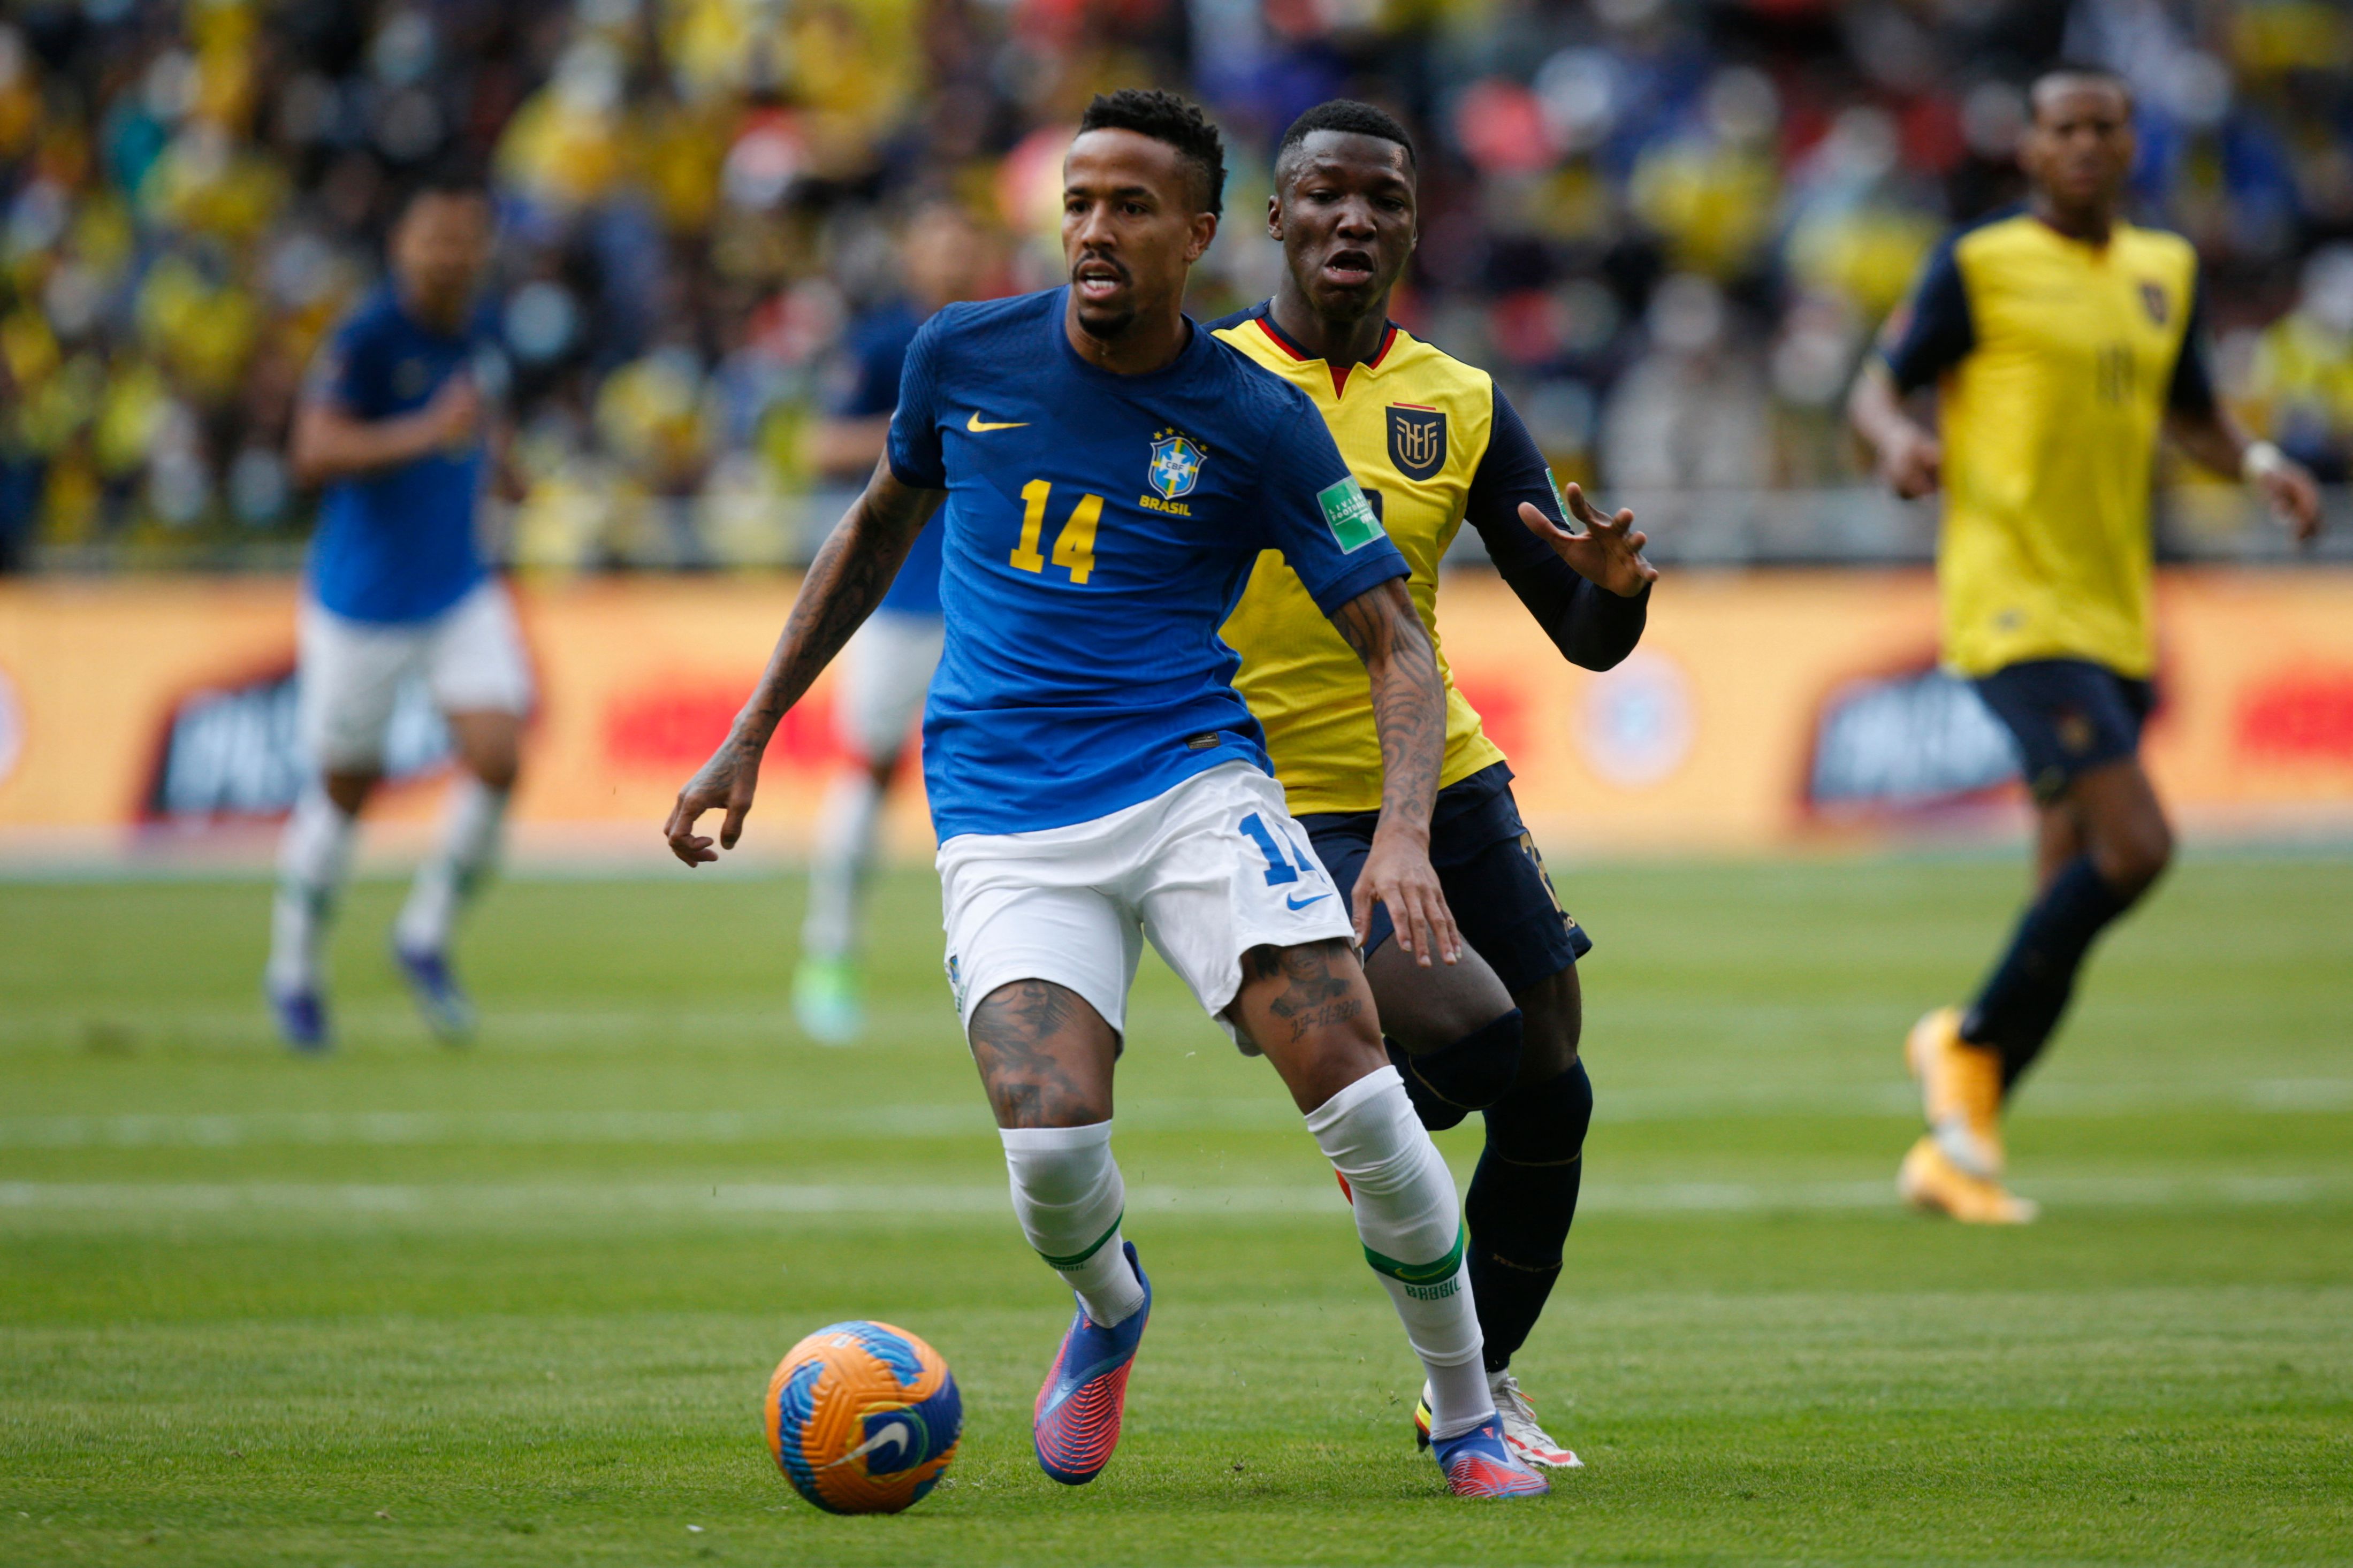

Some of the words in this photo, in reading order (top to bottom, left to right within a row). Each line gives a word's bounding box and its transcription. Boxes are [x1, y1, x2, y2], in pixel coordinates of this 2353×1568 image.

[1166, 461, 1184, 471] CBF
[1139, 494, 1192, 517] BRASIL
[1328, 493, 1362, 515] LIVING
[1331, 500, 1366, 522] FOOTBALL
[1009, 478, 1105, 585] 14
